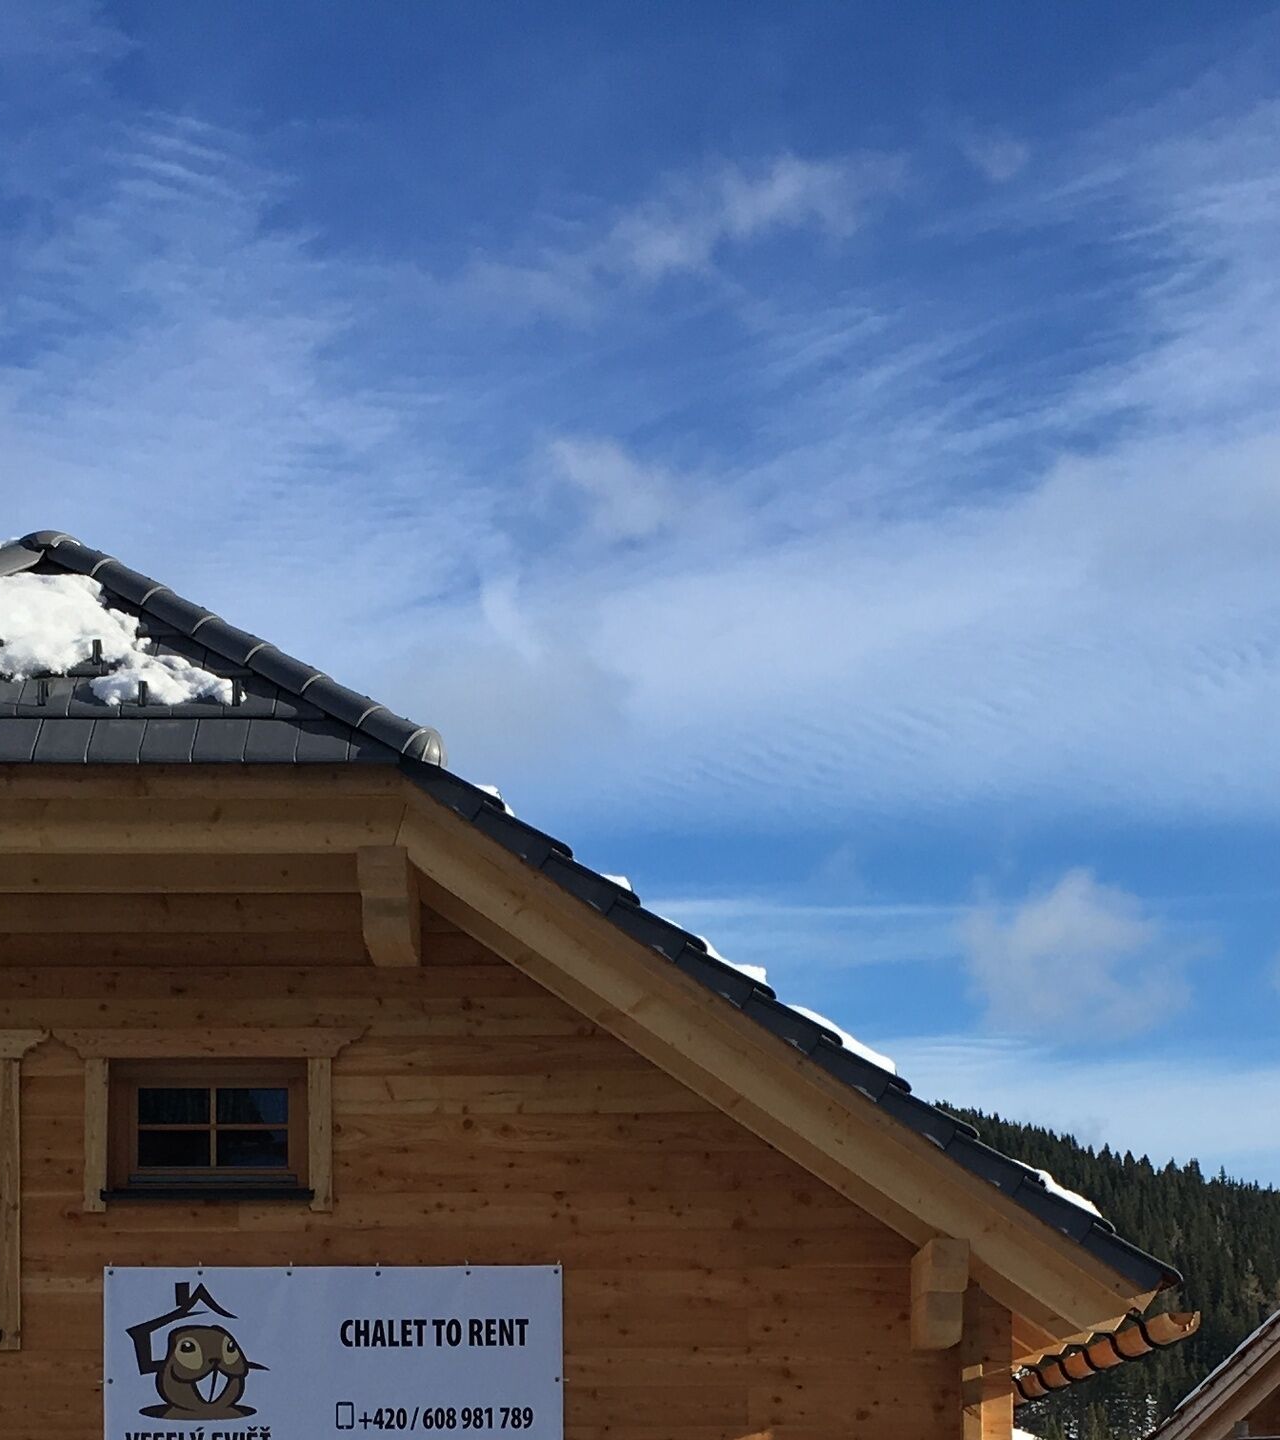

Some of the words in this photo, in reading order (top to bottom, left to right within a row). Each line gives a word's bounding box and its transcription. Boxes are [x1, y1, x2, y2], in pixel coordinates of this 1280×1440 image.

[340, 1319, 427, 1347] CHALET
[432, 1319, 462, 1347] TO
[469, 1318, 529, 1347] RENT
[358, 1407, 407, 1430] +420
[423, 1407, 457, 1430] 608
[461, 1407, 493, 1429] 981
[500, 1407, 534, 1429] 789
